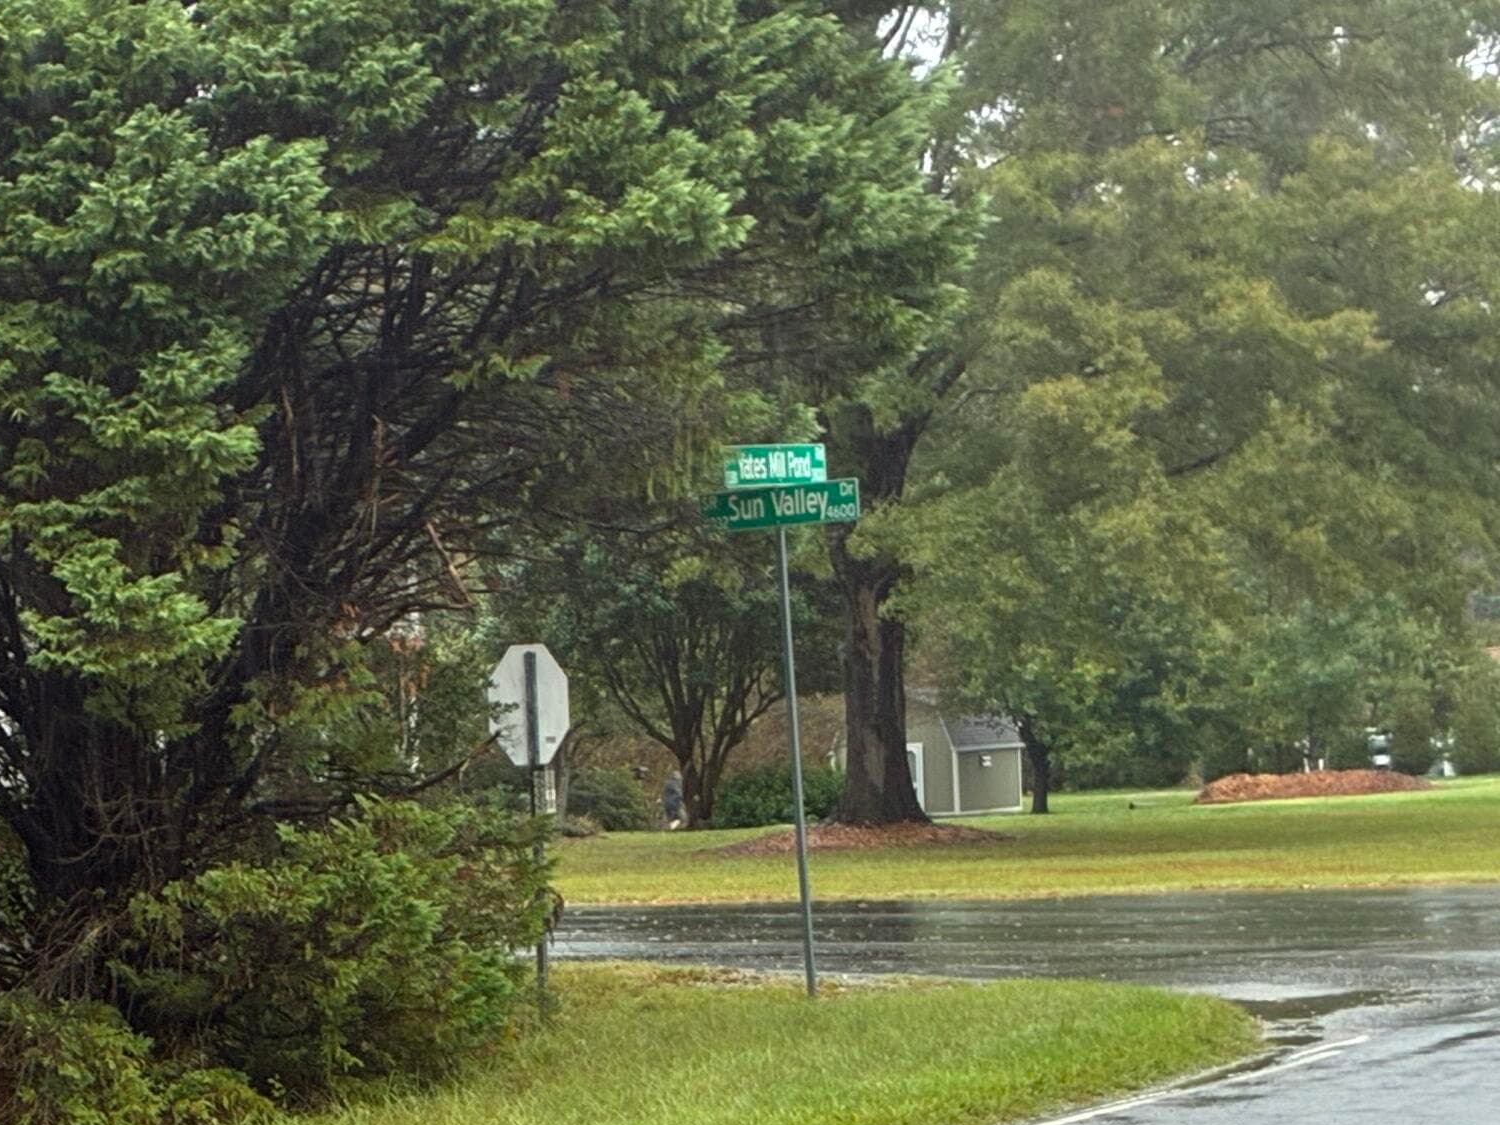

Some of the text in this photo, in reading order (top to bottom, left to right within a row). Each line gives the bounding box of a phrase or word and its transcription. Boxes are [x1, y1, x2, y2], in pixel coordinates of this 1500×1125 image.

[769, 452, 786, 477] Mill
[788, 451, 812, 477] Pond
[839, 482, 854, 496] Dr
[728, 488, 828, 521] Sun Valley
